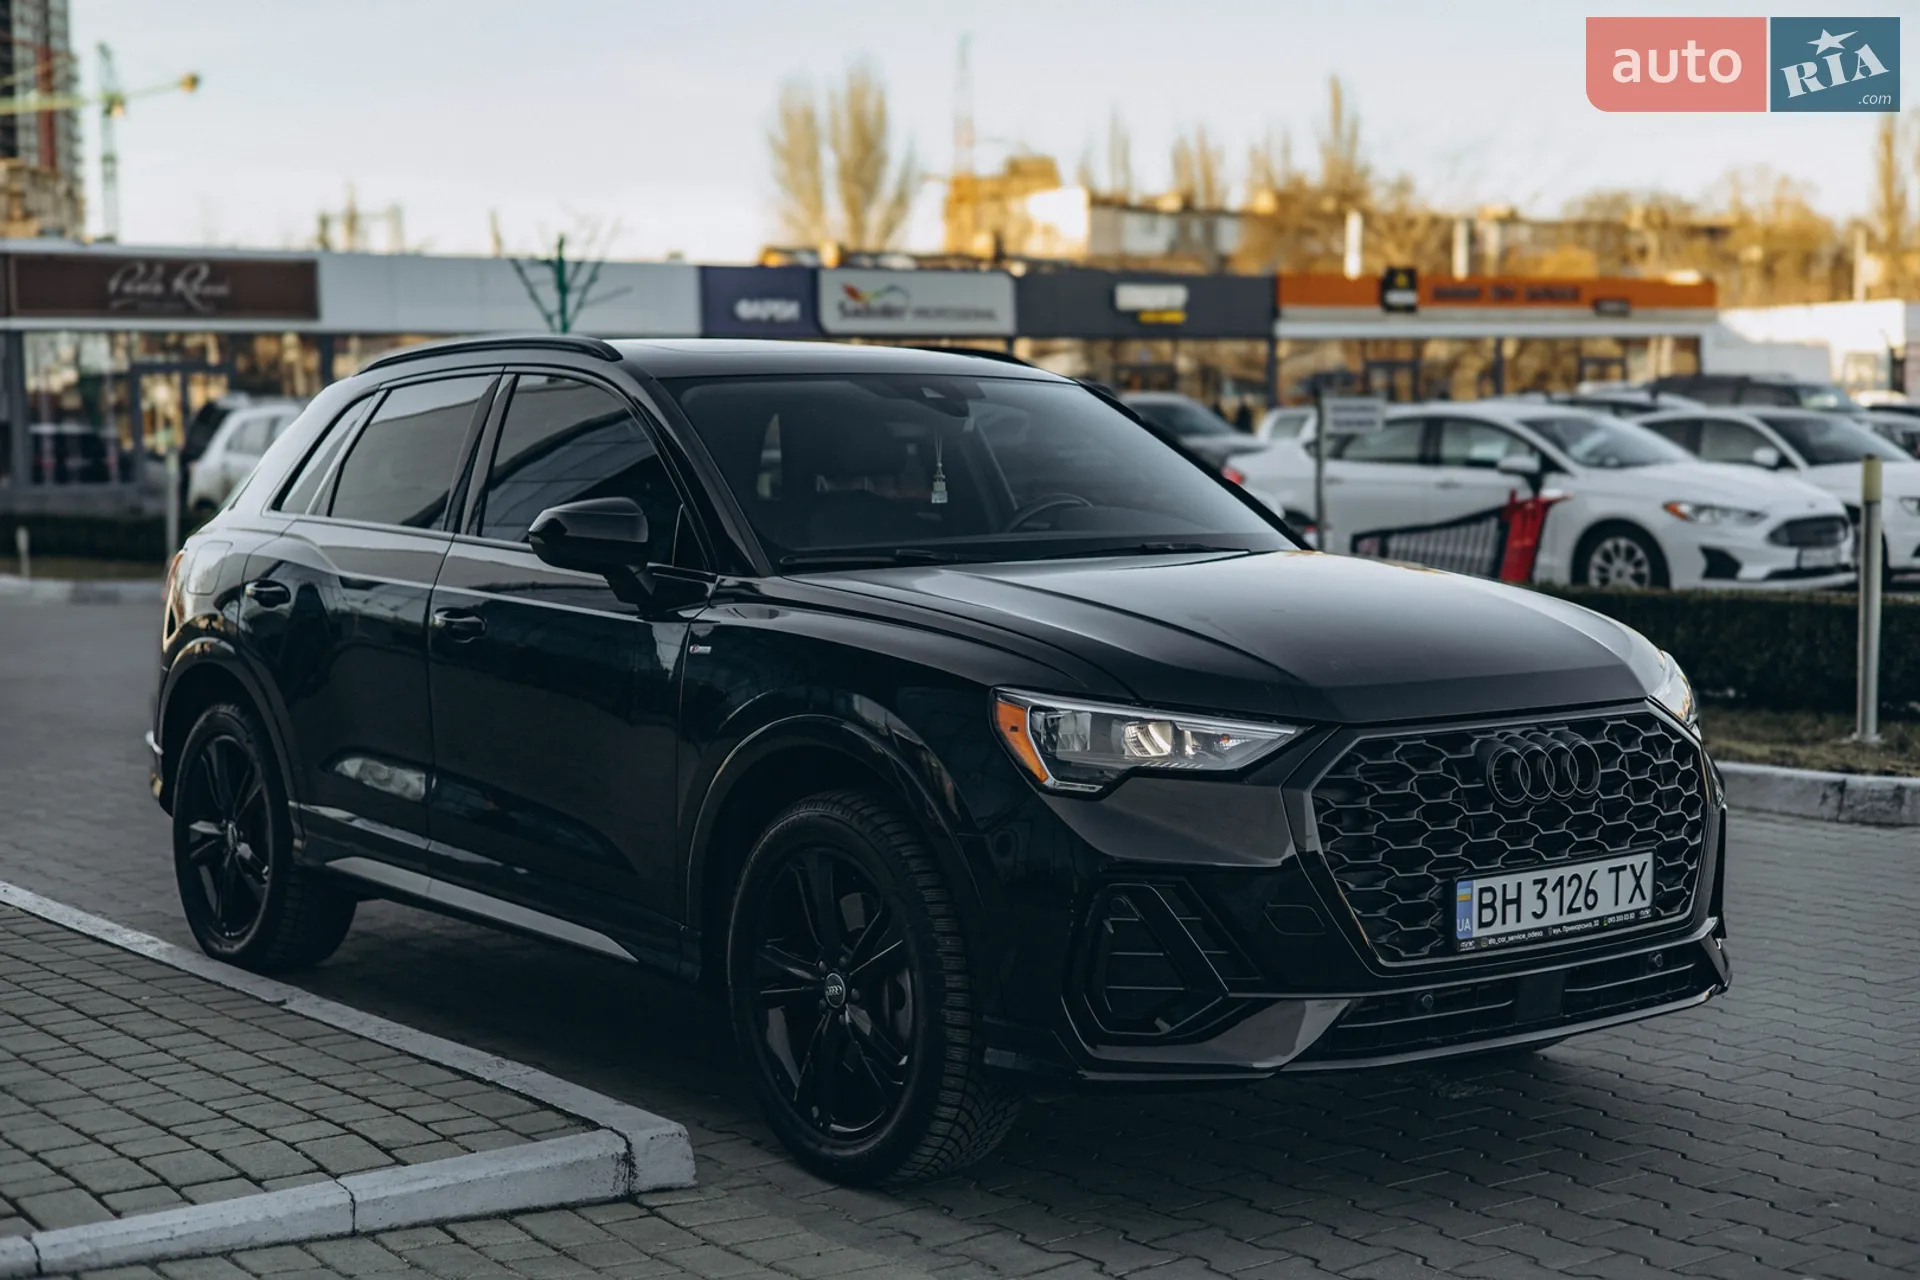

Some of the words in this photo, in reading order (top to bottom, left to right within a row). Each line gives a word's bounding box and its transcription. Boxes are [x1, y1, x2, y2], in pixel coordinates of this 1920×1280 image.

[1478, 882, 1522, 929] BH
[1531, 869, 1599, 919] 3126
[1608, 862, 1648, 906] TX
[1457, 918, 1472, 932] UA
